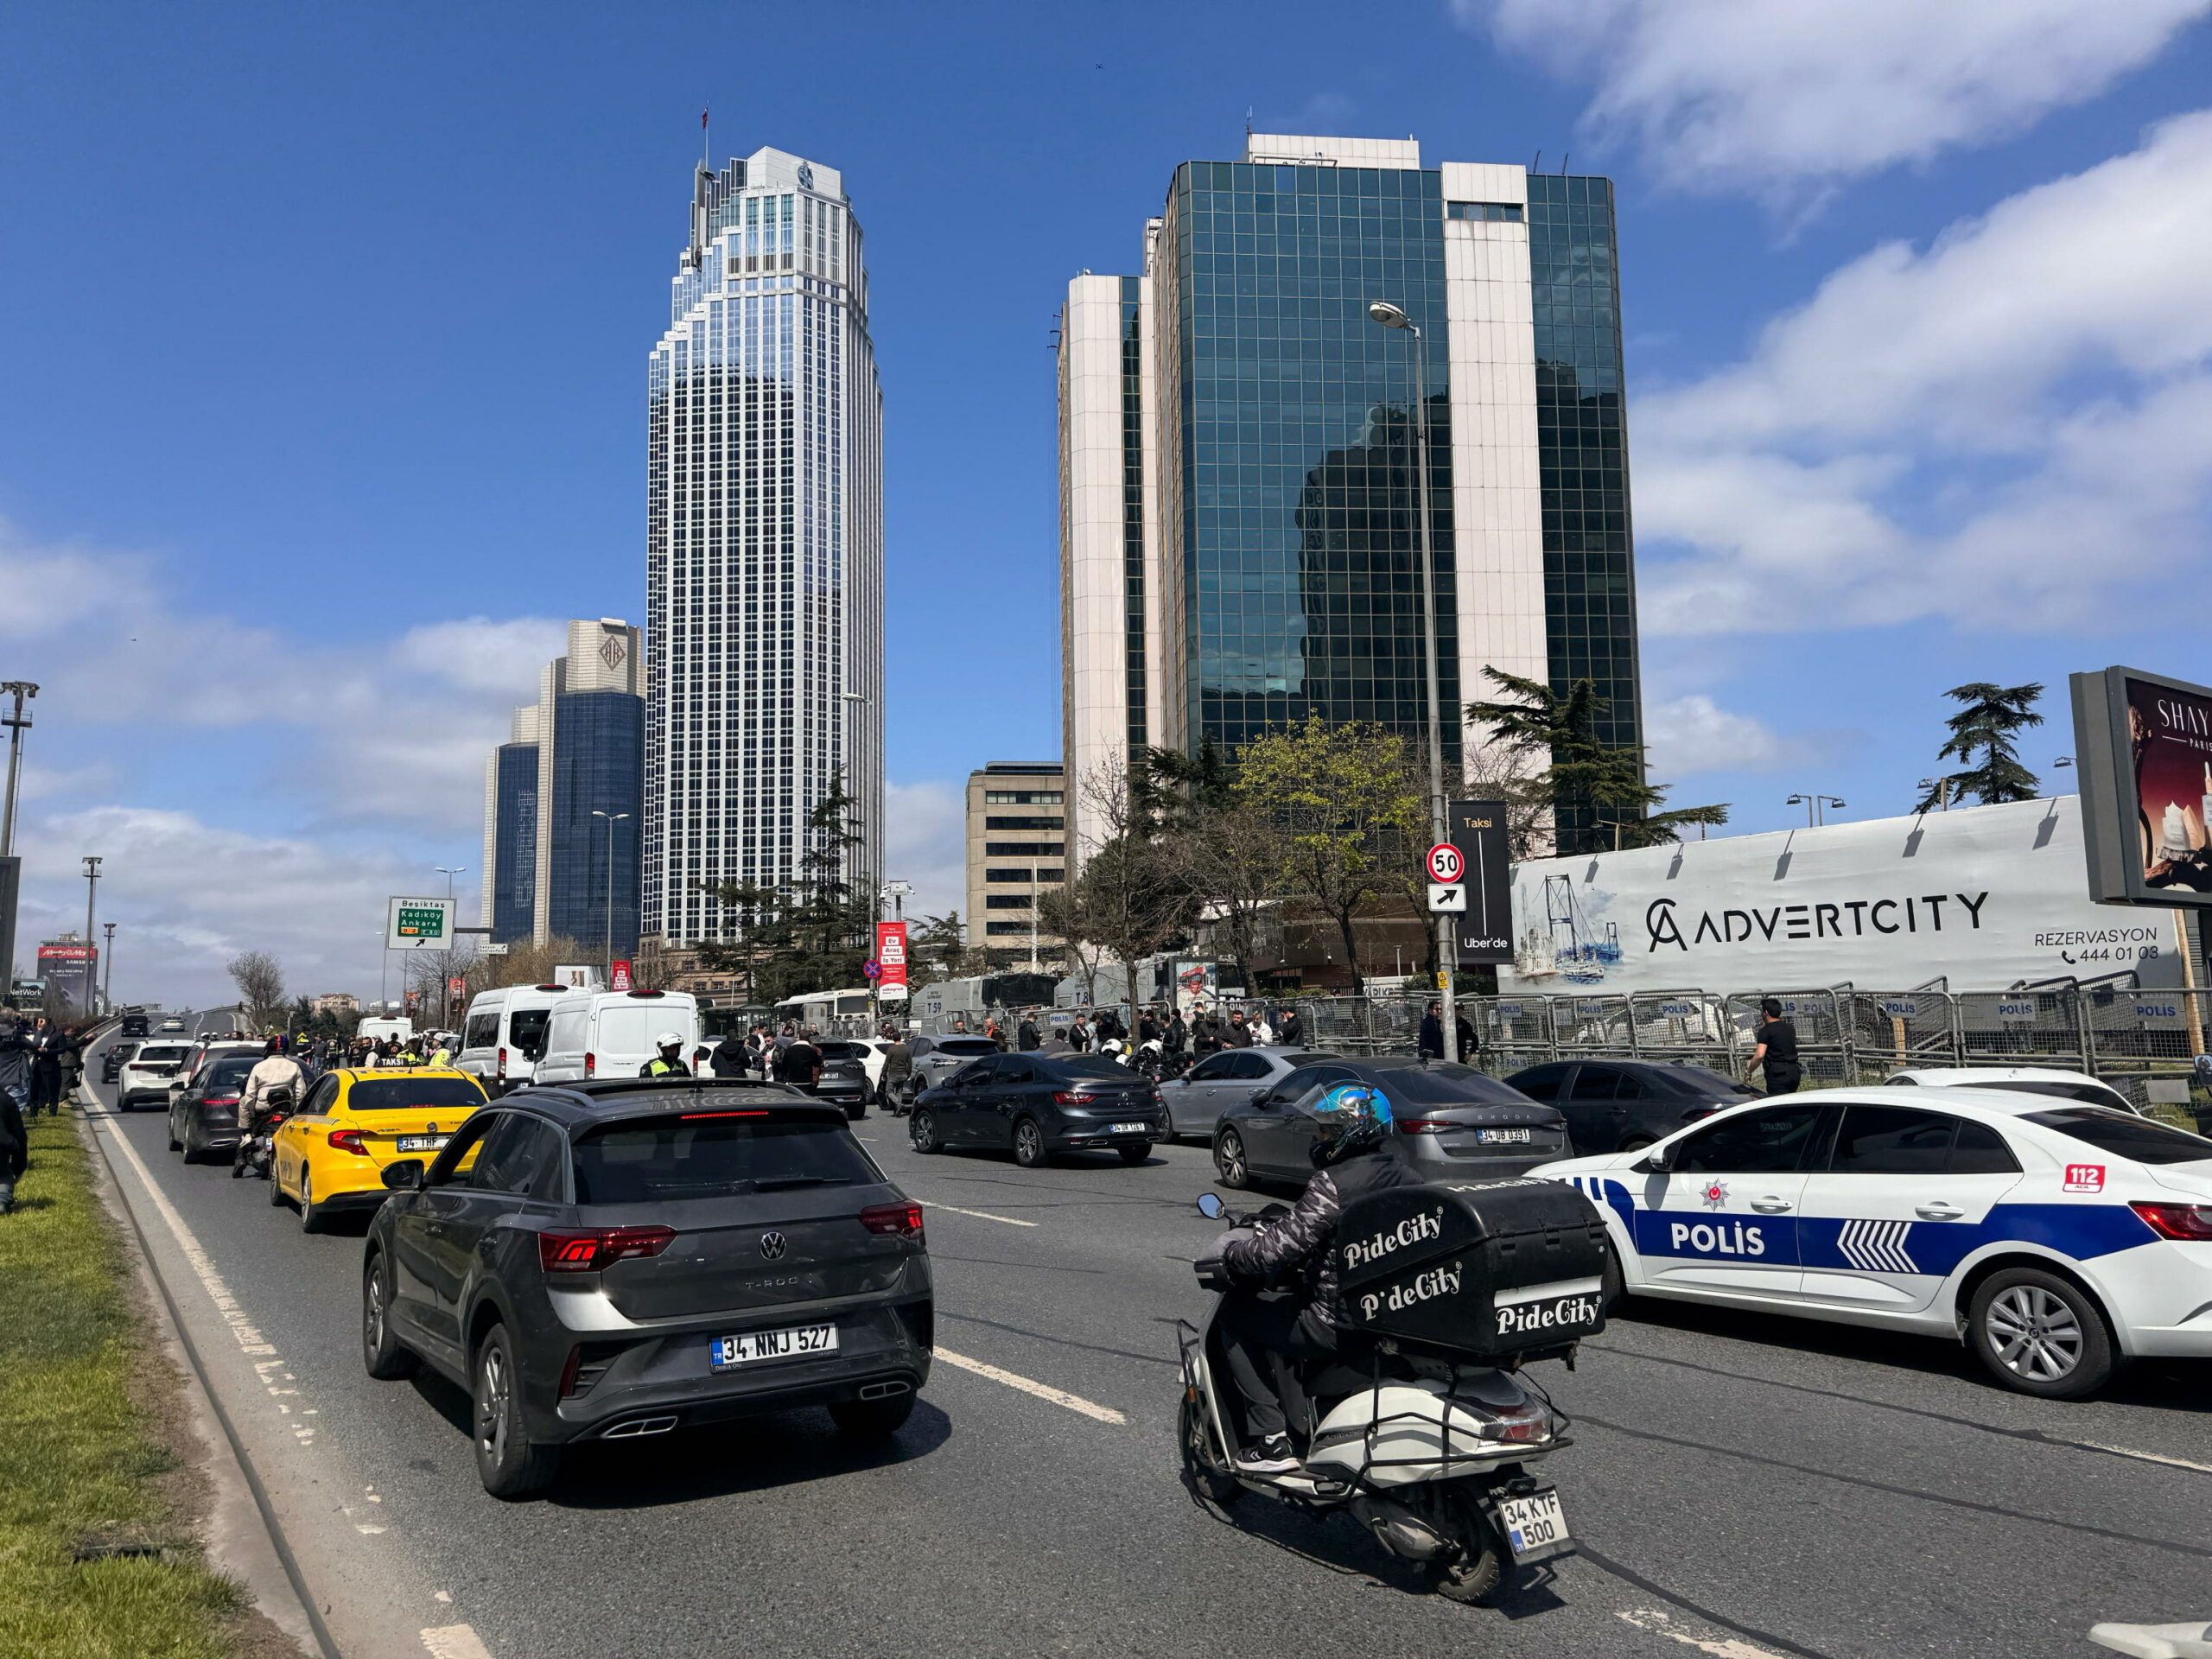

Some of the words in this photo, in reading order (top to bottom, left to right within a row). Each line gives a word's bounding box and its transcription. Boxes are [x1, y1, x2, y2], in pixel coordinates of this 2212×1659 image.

[1464, 817, 1492, 829] Taksi
[1435, 854, 1458, 873] 50
[401, 910, 442, 920] Kadıköy
[401, 918, 437, 927] Ankara
[1694, 892, 1989, 944] ADVERTCITY
[2035, 927, 2157, 946] REZERVASYON
[2080, 948, 2110, 962] 444
[2116, 947, 2132, 961] 01
[2139, 945, 2158, 960] 03
[933, 1002, 942, 1013] 59
[2137, 1002, 2176, 1017] POLİS
[403, 1138, 415, 1147] 34
[420, 1136, 437, 1147] THF
[1483, 1129, 1493, 1141] 34
[1496, 1129, 1506, 1140] UB
[1508, 1128, 1528, 1140] 0391
[2070, 1167, 2099, 1184] 112
[1344, 1211, 1442, 1270] PideCity
[1671, 1220, 1765, 1255] POLİS
[1361, 1267, 1460, 1321] PdeCity
[1496, 1298, 1599, 1335] PideCity
[724, 1337, 747, 1361] 34
[754, 1331, 791, 1357] NNJ
[798, 1325, 830, 1351] 527
[1504, 1503, 1528, 1525] 34
[1528, 1493, 1556, 1519] KTF
[1522, 1519, 1555, 1545] 500
